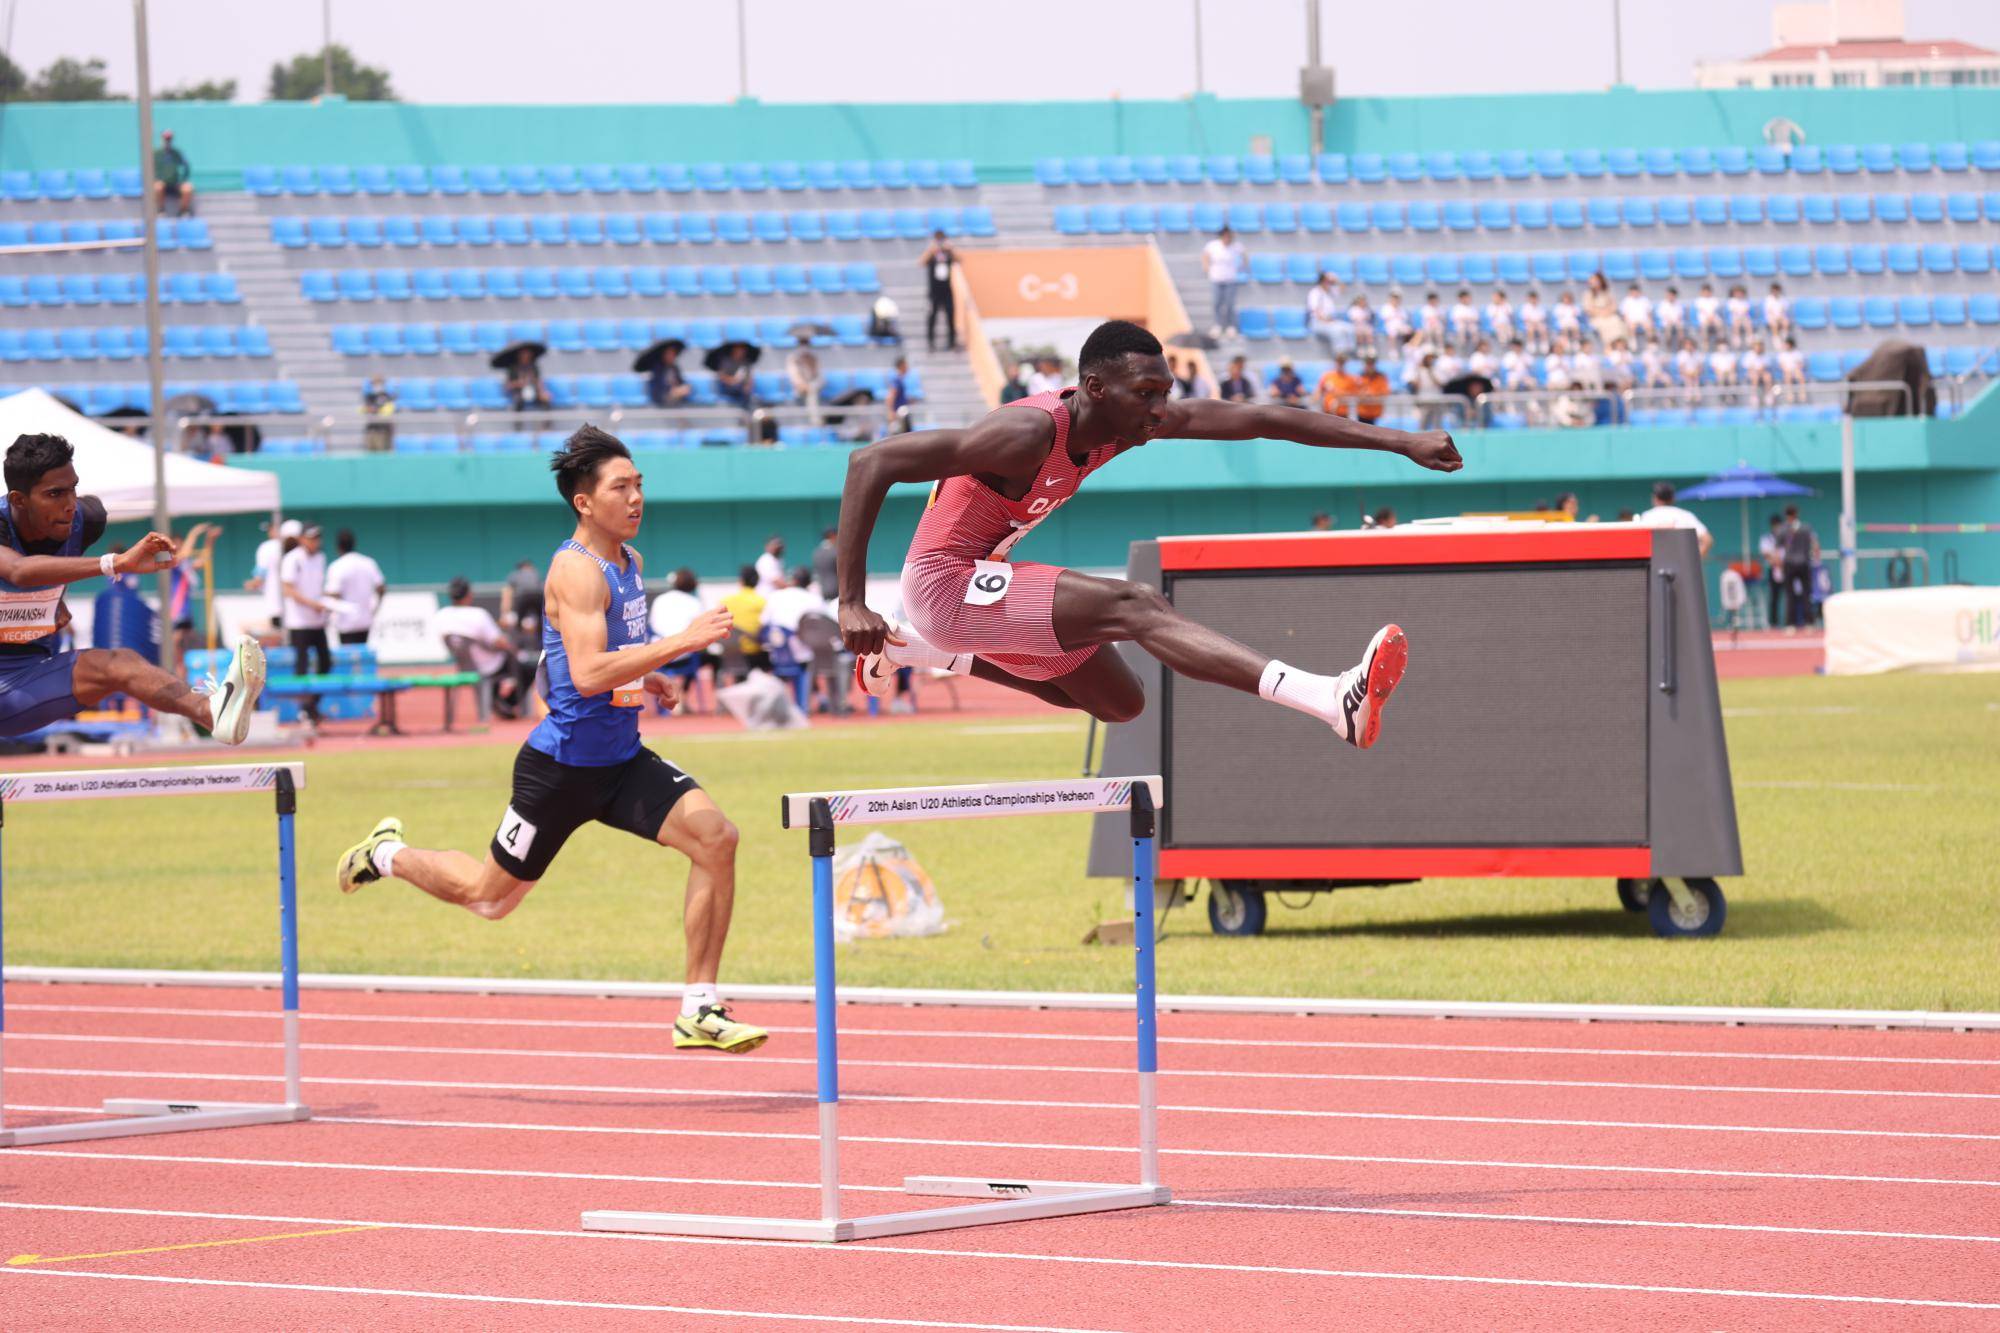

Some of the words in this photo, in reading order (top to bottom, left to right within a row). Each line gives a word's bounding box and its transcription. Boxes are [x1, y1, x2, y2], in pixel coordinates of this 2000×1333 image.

[1019, 272, 1079, 301] C-3
[34, 783, 53, 793] 20th
[55, 782, 79, 792] Asian
[81, 781, 98, 791] U20
[100, 779, 137, 789] Athletics
[139, 777, 204, 788] Championships
[205, 775, 241, 785] Yecheon
[868, 801, 889, 813] 20th
[891, 800, 918, 811] Asian
[920, 798, 939, 810] U20
[941, 796, 982, 808] Athletics
[984, 792, 1055, 807] Championships
[1056, 790, 1095, 802] Yecheon
[506, 822, 521, 849] 4
